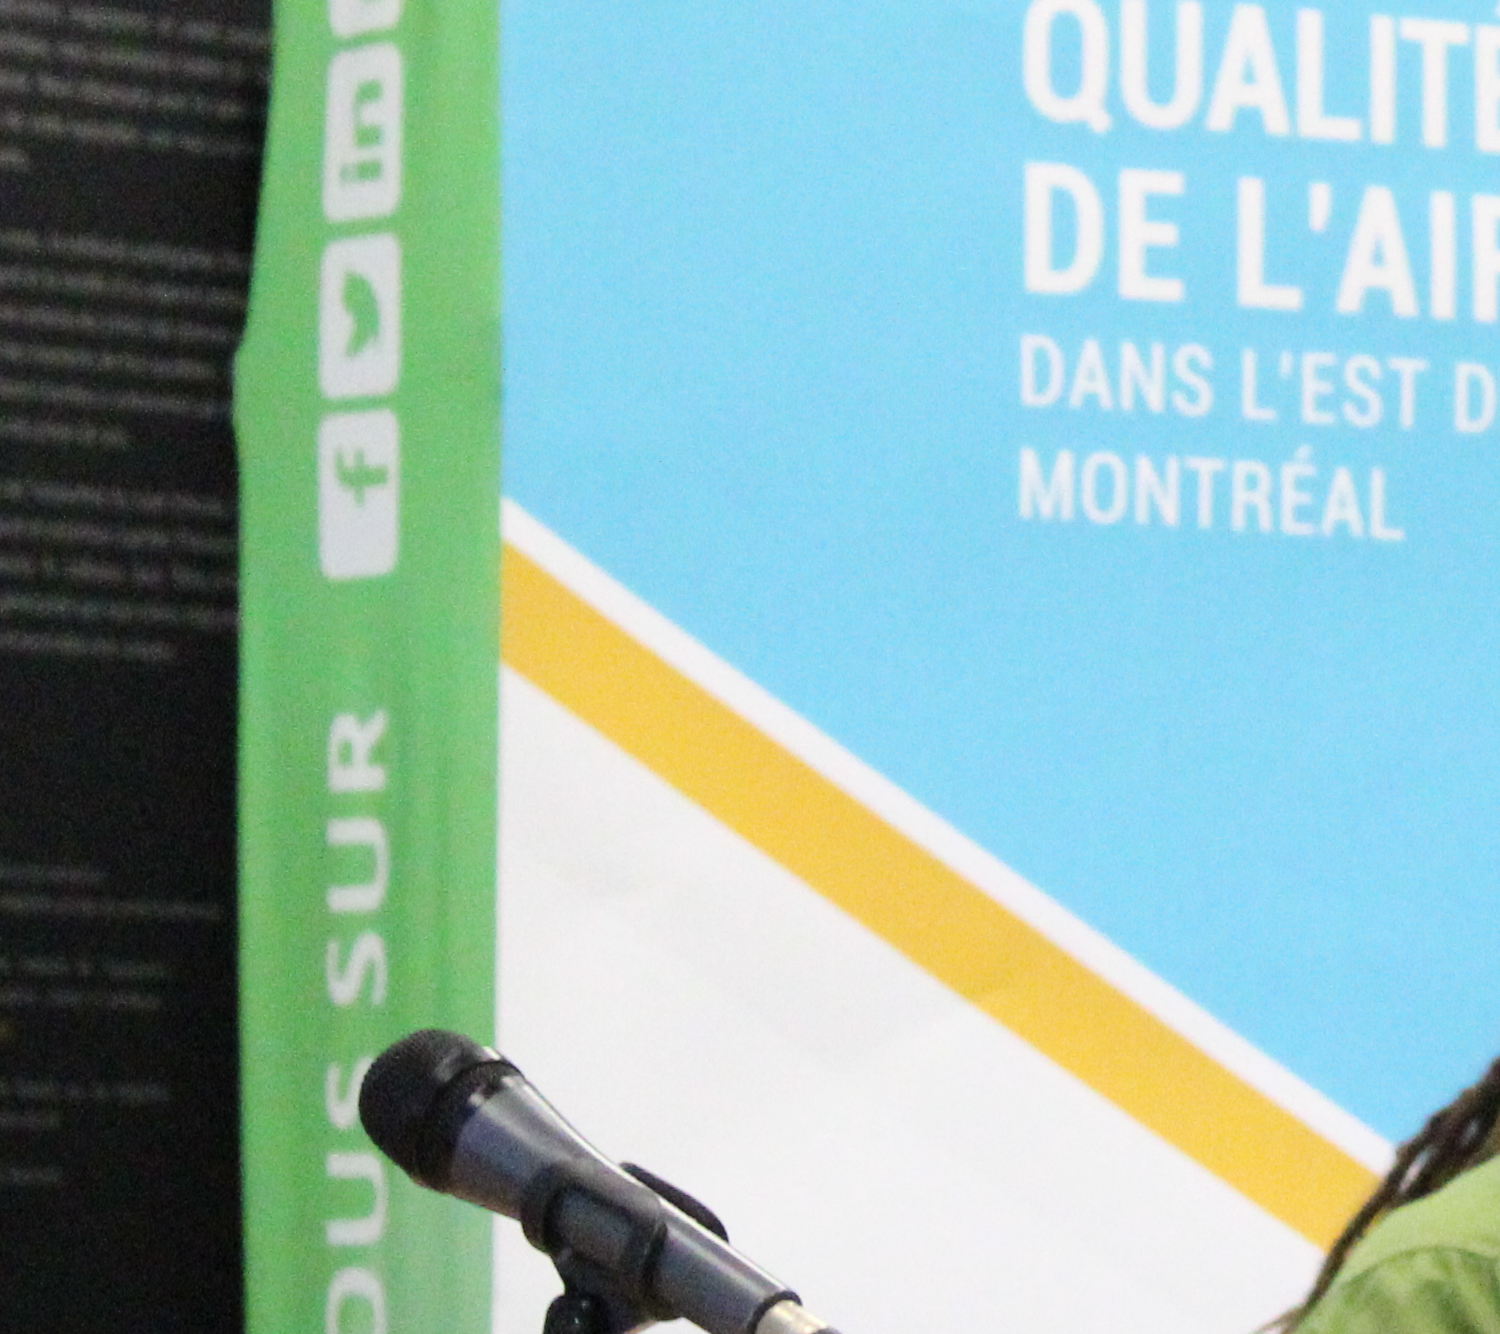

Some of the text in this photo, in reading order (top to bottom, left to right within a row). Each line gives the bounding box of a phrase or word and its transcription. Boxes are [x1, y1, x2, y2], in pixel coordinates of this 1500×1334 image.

[1023, 160, 1186, 303] DE
[1019, 334, 1214, 418] DANS
[1241, 348, 1429, 431] L'EST
[1018, 444, 1406, 542] MONTRÉAL
[325, 710, 390, 1006] SUR
